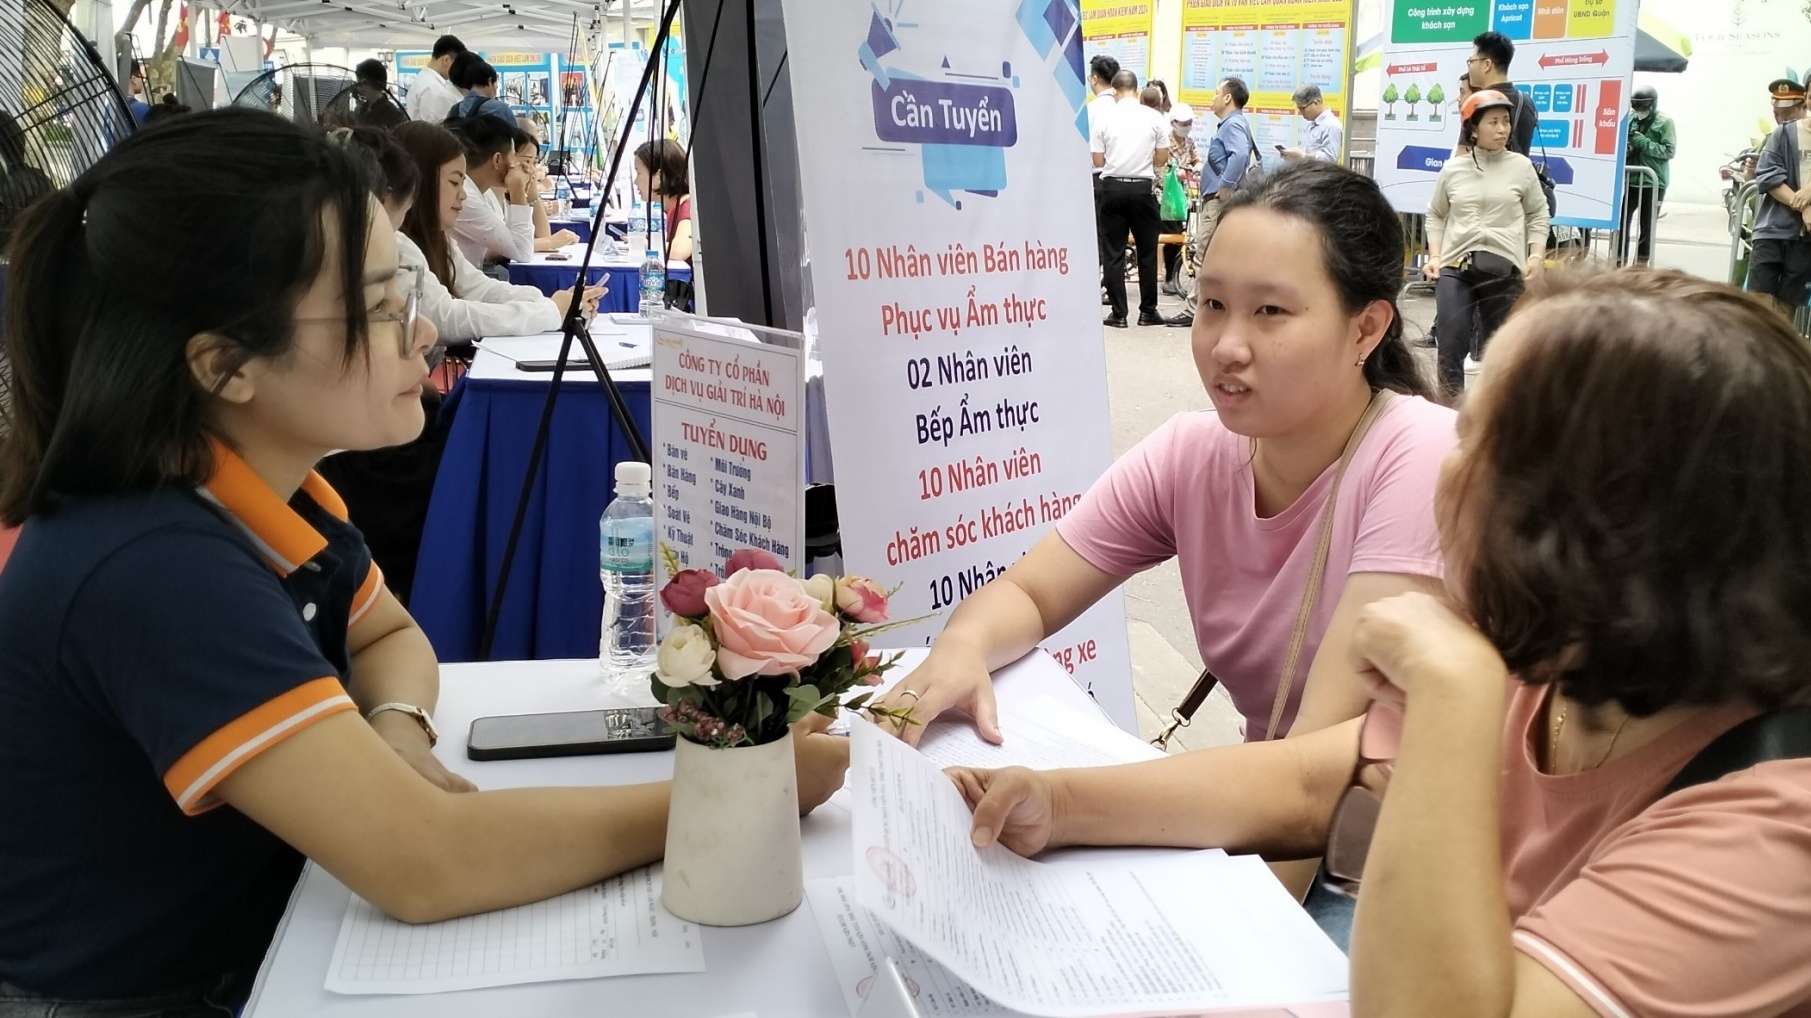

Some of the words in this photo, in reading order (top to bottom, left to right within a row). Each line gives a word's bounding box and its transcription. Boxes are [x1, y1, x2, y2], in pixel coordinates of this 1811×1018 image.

[1408, 8, 1426, 18] Công
[1427, 7, 1441, 16] trình
[1443, 7, 1456, 16] xây
[1457, 6, 1474, 16] dựng
[1501, 14, 1522, 23] Apricot
[1518, 3, 1529, 11] sạn
[1593, 9, 1610, 18] Quận
[1422, 21, 1442, 29] khách
[1443, 22, 1456, 31] sạn
[890, 90, 934, 129] Cần
[938, 95, 1002, 138] Tuyển
[1603, 106, 1616, 115] Sân
[1599, 118, 1616, 127] khấu
[1425, 158, 1442, 167] Gian
[844, 247, 871, 280] 10
[876, 244, 932, 279] Nhân
[936, 242, 978, 275] viên
[983, 241, 1020, 273] Bán
[1025, 240, 1069, 275] hàng
[882, 302, 932, 340] Phục
[936, 306, 960, 336] vụ
[966, 285, 999, 328] Ẩm
[1004, 293, 1046, 328] thực
[678, 348, 704, 372] CÔNG
[708, 358, 722, 376] TY
[726, 354, 740, 380] CỔ
[907, 358, 933, 390] 02
[937, 350, 989, 386] Nhân
[993, 345, 1032, 378] viên
[665, 374, 687, 396] DỊCH
[690, 380, 704, 402] VỤ
[706, 380, 727, 402] GIẢI
[730, 386, 746, 407] TRÍ
[749, 389, 763, 412] HÀ
[766, 394, 785, 420] NỘI
[916, 405, 953, 447] Bếp
[959, 393, 991, 437] Ẩm
[996, 398, 1039, 432] thực
[667, 444, 679, 459] Bán
[681, 418, 725, 450] TUYỂN
[730, 434, 767, 462] DỤNG
[667, 464, 679, 479] Bán
[680, 468, 696, 486] Hàng
[715, 457, 727, 473] Môi
[728, 462, 751, 482] Trường
[918, 466, 943, 500] 10
[948, 455, 999, 494] Nhân
[1003, 447, 1042, 481] viên
[667, 484, 679, 500] Bếp
[715, 479, 727, 496] Cây
[728, 482, 745, 500] Xanh
[682, 510, 691, 525] Vé
[715, 500, 730, 517] Giao
[731, 504, 748, 524] Hàng
[749, 510, 761, 528] Nội
[762, 515, 772, 533] Bộ
[667, 526, 676, 541] Kỹ
[676, 528, 694, 548] Thuật
[715, 521, 733, 540] Chăm
[735, 528, 748, 544] Sóc
[749, 532, 770, 552] Khách
[771, 537, 789, 559] Hàng
[886, 526, 941, 566] chăm
[946, 514, 977, 550] sóc
[981, 498, 1036, 539] khách
[680, 550, 689, 567] Hộ
[929, 575, 954, 610] 10
[1077, 639, 1096, 664] xe
